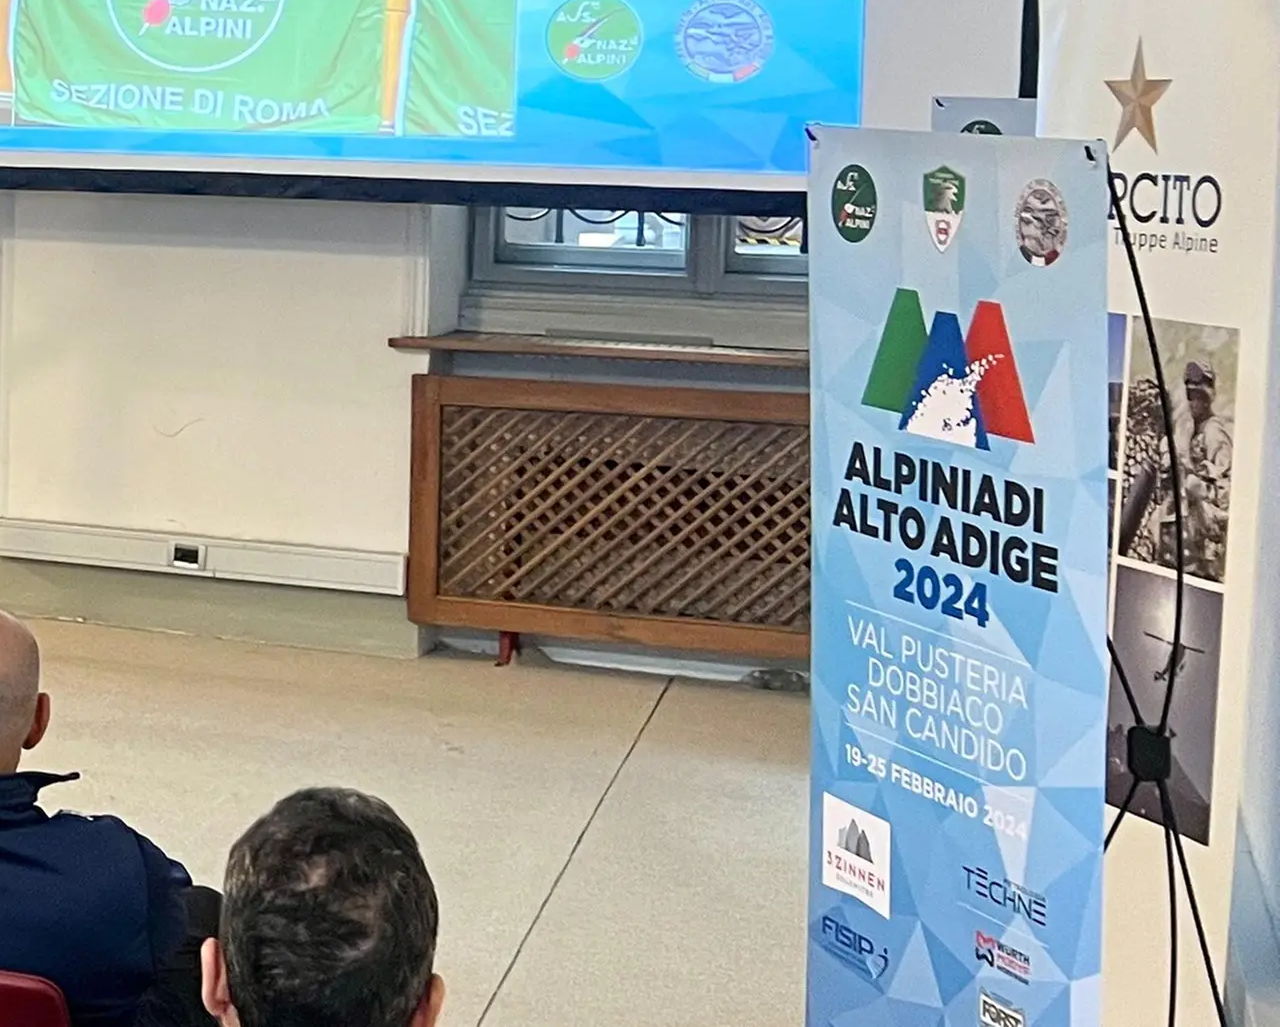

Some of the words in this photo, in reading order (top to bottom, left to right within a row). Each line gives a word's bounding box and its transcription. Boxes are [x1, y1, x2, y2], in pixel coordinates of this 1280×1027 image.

[165, 17, 252, 40] ALPINI
[577, 53, 627, 65] ALPINI
[50, 79, 185, 112] SEZIONE
[193, 90, 223, 117] DI
[233, 94, 331, 124] ROMA
[1108, 172, 1222, 228] RCITO
[1172, 231, 1219, 254] Alpine
[844, 441, 1044, 534] ALPINIADI
[833, 488, 926, 551] ALTO
[930, 516, 1058, 593] ADIGE
[893, 558, 989, 628] 2024
[848, 615, 894, 660] VAL
[902, 635, 1028, 710] PUSTERIA
[868, 657, 1003, 735] DOBBIACO
[846, 684, 896, 729] SAN
[905, 708, 1026, 781] CANDIDO
[845, 743, 886, 778] 19-25
[891, 763, 978, 818] FEBBRAIO
[984, 805, 1028, 841] 2024
[827, 850, 833, 865] 3
[835, 855, 885, 892] ZINNEN
[962, 866, 1046, 926] TECHNE
